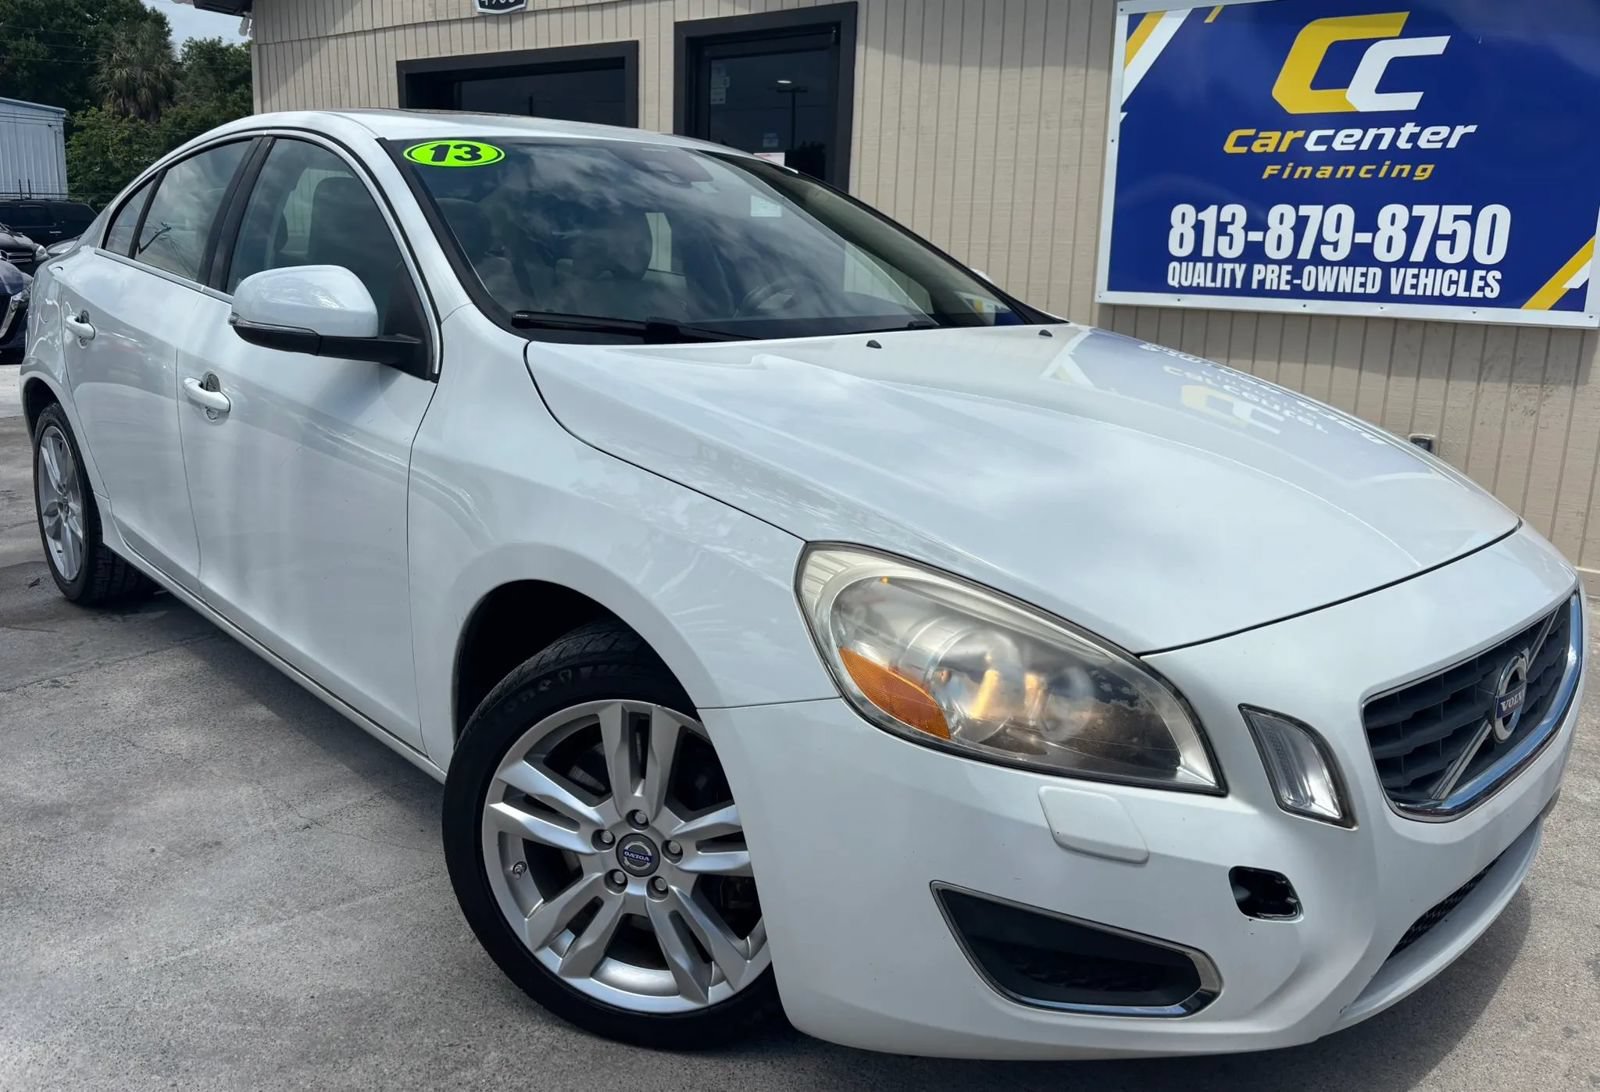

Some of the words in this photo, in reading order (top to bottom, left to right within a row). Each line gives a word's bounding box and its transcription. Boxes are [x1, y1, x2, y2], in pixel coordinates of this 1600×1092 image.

[425, 143, 483, 163] 13
[1262, 160, 1436, 181] Financing
[1168, 203, 1512, 265] 813-879-8750
[1167, 261, 1247, 288] QUALITY
[1251, 264, 1383, 295] PRE-OWNED
[1390, 267, 1503, 299] VEHICLES
